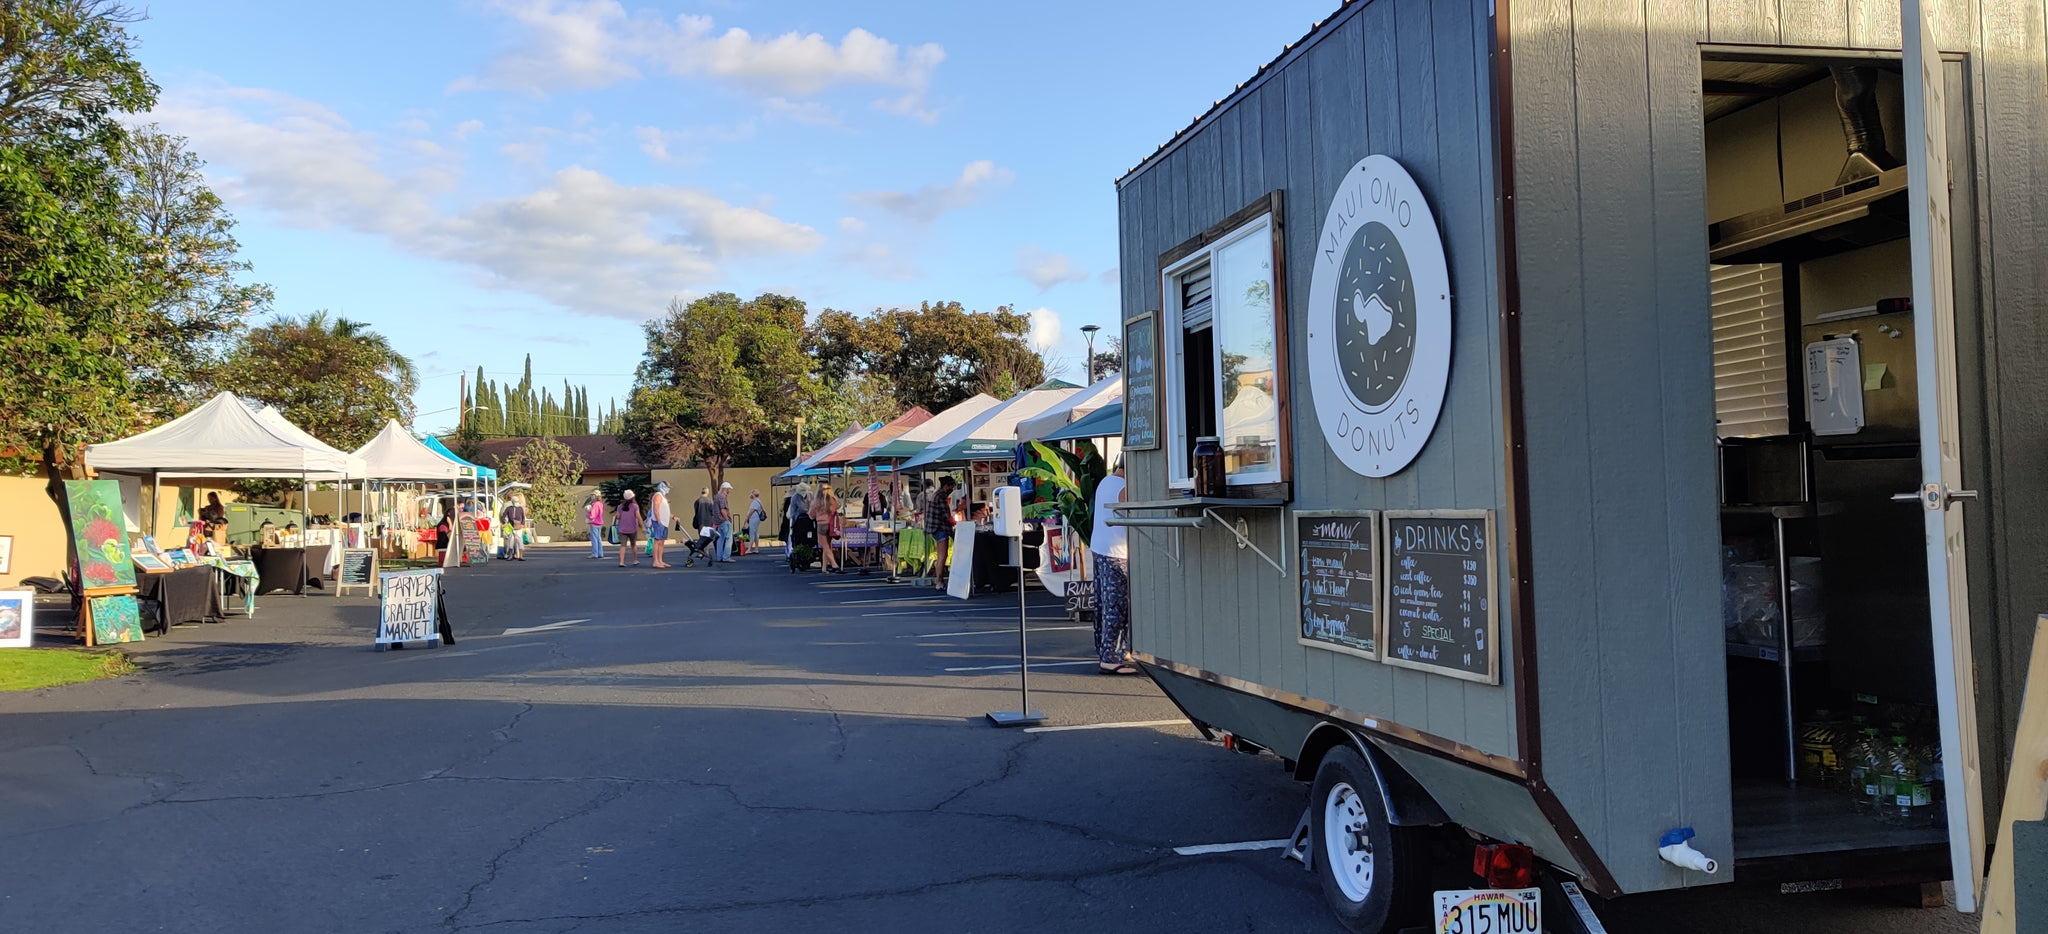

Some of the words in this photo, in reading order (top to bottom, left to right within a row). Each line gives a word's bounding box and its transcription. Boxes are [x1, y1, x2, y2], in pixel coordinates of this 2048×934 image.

[1325, 183, 1363, 265] MAUI
[1371, 177, 1411, 228] ONO
[1336, 399, 1420, 457] DONUTS
[1405, 525, 1471, 552] DRINKS
[1066, 596, 1095, 610] SALE
[1303, 579, 1312, 606] 2
[1430, 584, 1443, 598] tea
[386, 620, 430, 640] MARKET
[1303, 608, 1313, 637] 3
[1422, 625, 1454, 641] SPECIAL
[1451, 904, 1491, 934] 315
[1497, 902, 1538, 934] MUU
